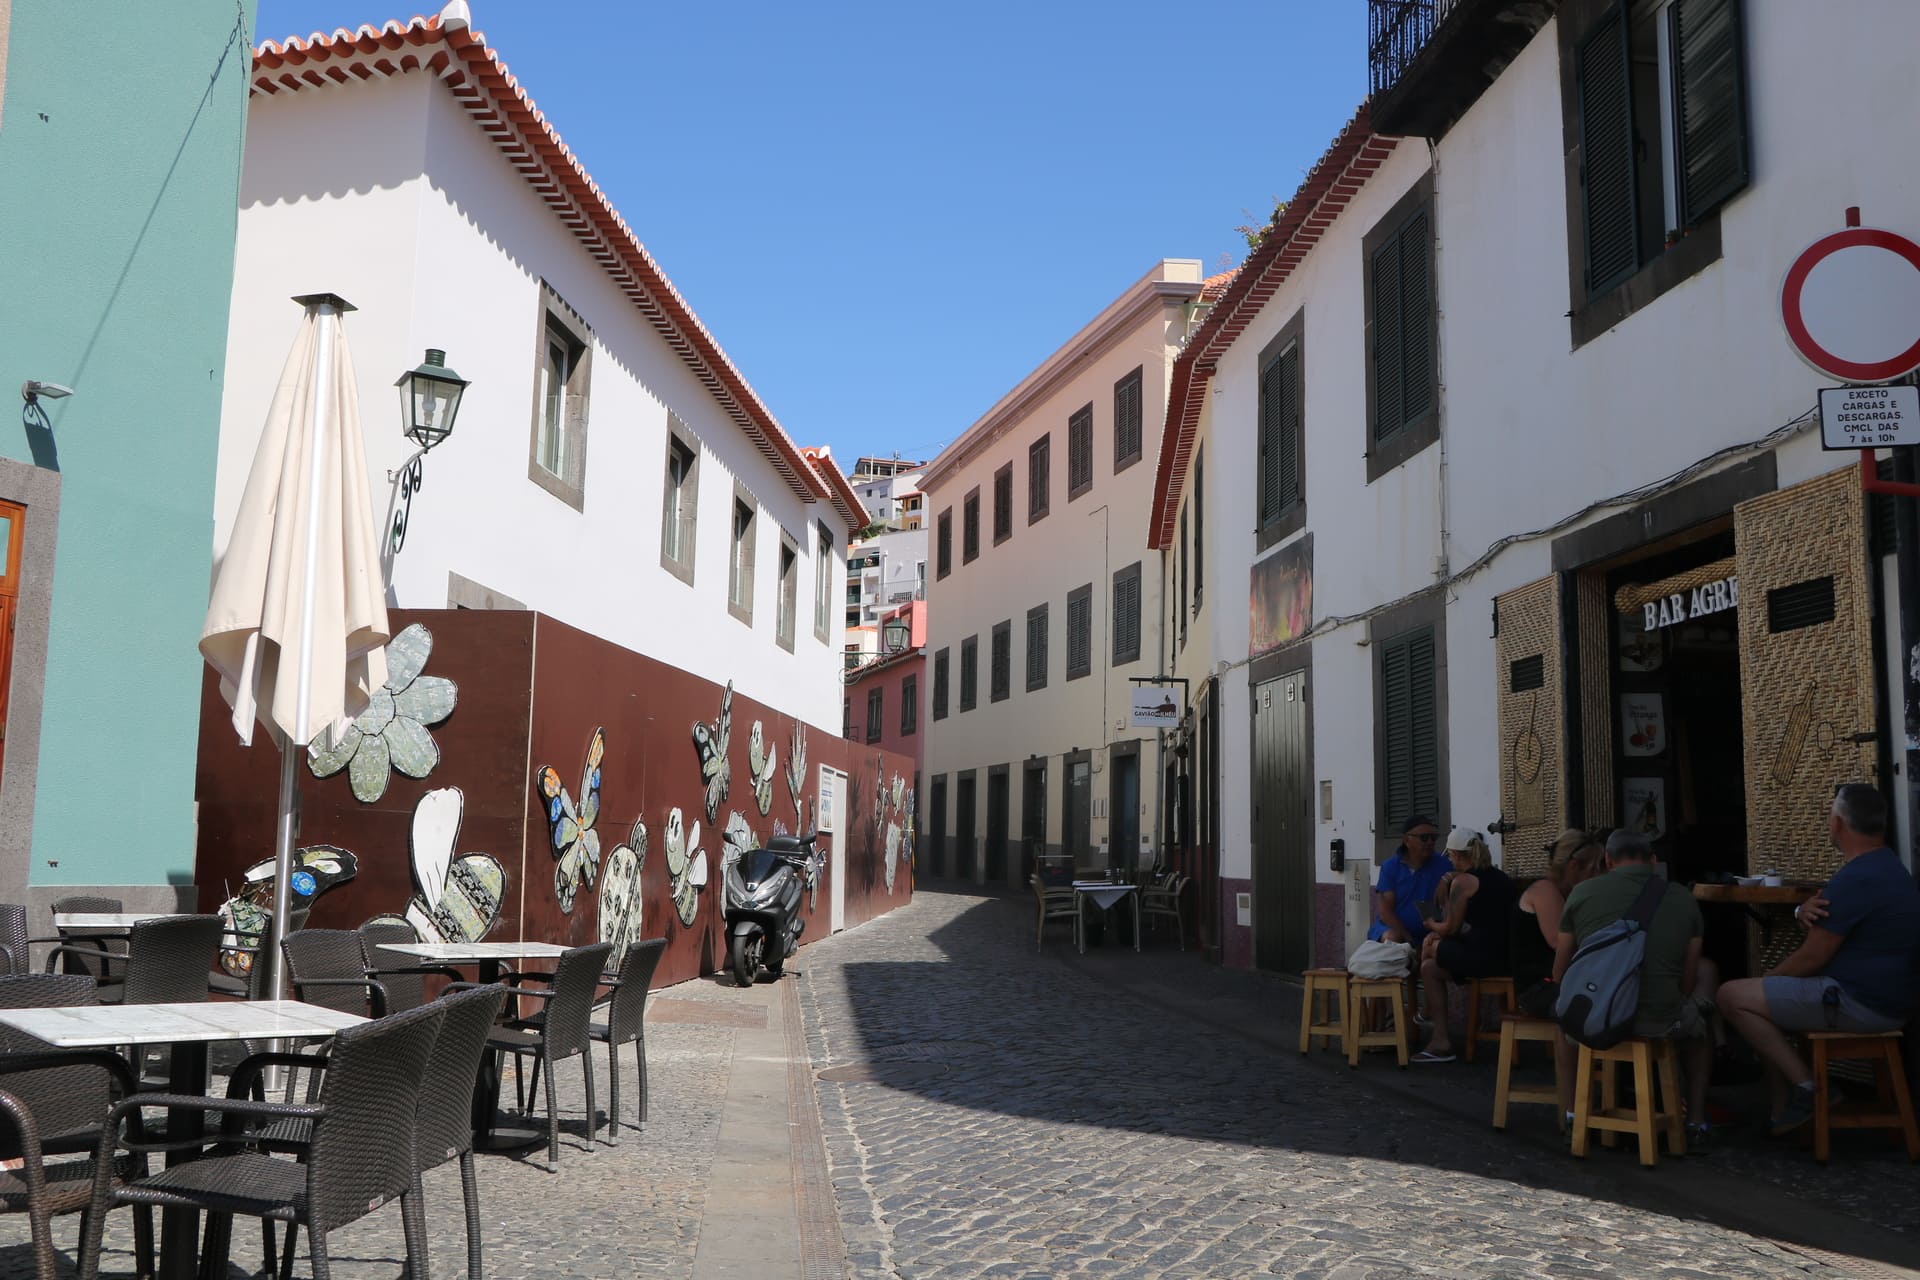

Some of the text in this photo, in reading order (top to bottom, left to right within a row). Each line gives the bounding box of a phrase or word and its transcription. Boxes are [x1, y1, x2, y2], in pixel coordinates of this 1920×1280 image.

[1849, 390, 1888, 399] EXCETO
[1842, 401, 1885, 410] CARGAS
[1843, 422, 1899, 432] CMCL DAS
[1879, 434, 1895, 442] 10h
[1643, 593, 1686, 632] BAR
